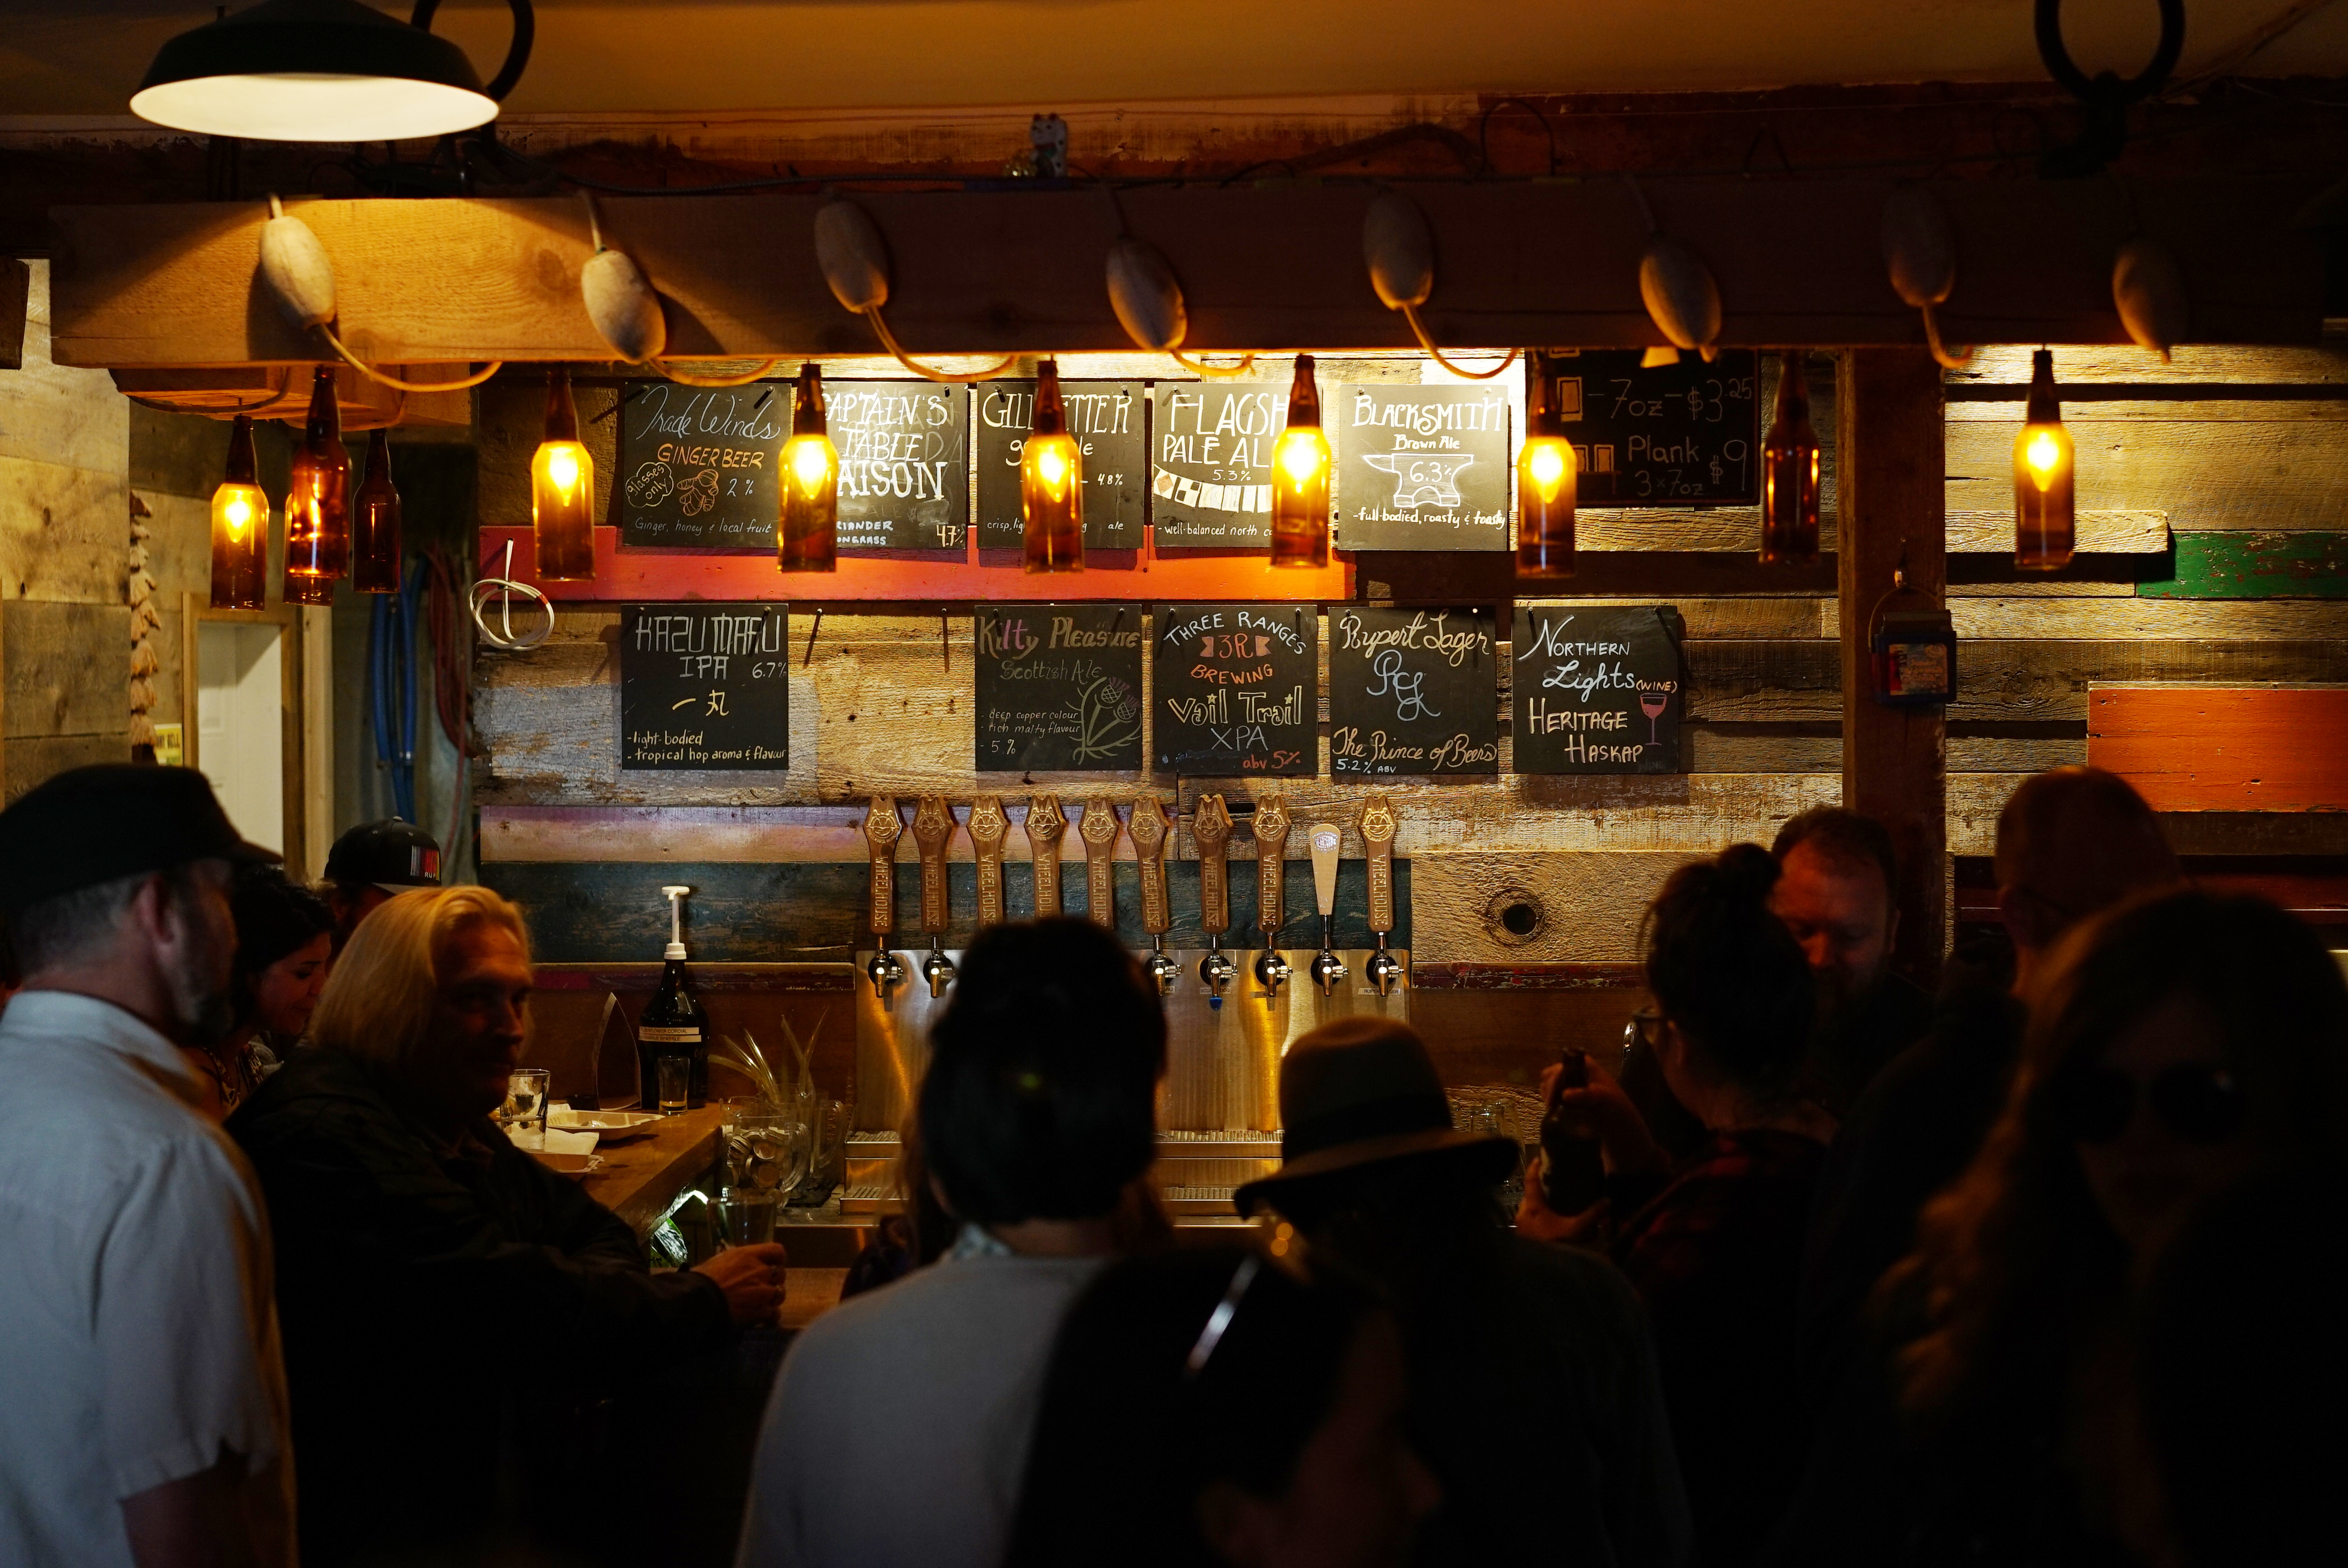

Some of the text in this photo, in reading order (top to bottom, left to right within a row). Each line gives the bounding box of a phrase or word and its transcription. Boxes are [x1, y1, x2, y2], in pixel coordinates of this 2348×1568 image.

[636, 385, 781, 440] Trade Winds
[1351, 394, 1505, 436] BLACKSMITH
[838, 425, 924, 462] TABLE
[1163, 434, 1221, 465] PALE
[1393, 434, 1461, 451] Brown Ale
[1628, 435, 1701, 463] Plank
[657, 443, 765, 470] GINGER BEER
[627, 465, 665, 497] glasses
[836, 459, 948, 501] AISON
[1097, 473, 1124, 486] 4.8%
[1212, 469, 1252, 482] 5.3%
[1409, 461, 1452, 483] 6.3%
[645, 477, 668, 500] only
[635, 517, 669, 536] Ginger,
[675, 519, 703, 536] honey
[719, 517, 744, 533] local
[746, 518, 773, 534] fruit
[836, 520, 894, 532] RIANDER
[1108, 520, 1124, 530] ale
[1229, 524, 1258, 536] north
[1424, 509, 1461, 529] roasty
[1472, 509, 1506, 530] toasty
[836, 535, 887, 546] ONGRASS
[1048, 616, 1141, 649] Pleasure
[1162, 611, 1307, 656] THREE RANGES
[1217, 632, 1254, 659] 3R
[679, 655, 787, 680] IPA 6.7%
[1000, 659, 1103, 685] Scottish Ale
[1190, 663, 1274, 685] BREWING
[1541, 659, 1678, 703] Lights (WINE)
[988, 707, 1011, 723] deep
[1016, 711, 1047, 724] copper
[1049, 709, 1079, 720] colour
[1237, 684, 1302, 726] Trail
[1528, 697, 1629, 735] HERITAGE
[988, 721, 1009, 733] rich
[1014, 723, 1046, 739] malty
[1047, 721, 1081, 734] flavour
[1209, 725, 1269, 751] XPA
[635, 747, 684, 765] tropical
[689, 747, 709, 764] hop
[712, 750, 743, 760] aroma
[1242, 754, 1268, 770] abv
[1332, 726, 1498, 771] The Prince of Beers
[1563, 733, 1644, 764] HASKAP
[1336, 758, 1397, 775] 5.2% ABV
[873, 856, 889, 927] WHEELHOUSE
[925, 854, 940, 926] WHEELHOUSE
[981, 854, 997, 926] WHEELHOUSE
[1037, 853, 1052, 917] WHEELHOU
[1142, 857, 1161, 927] WHEELHOUSE
[1204, 857, 1219, 927] WHEELHOUSE
[1263, 854, 1276, 926] WHEELHOUSE
[1372, 854, 1388, 925] WHEELHOUSE
